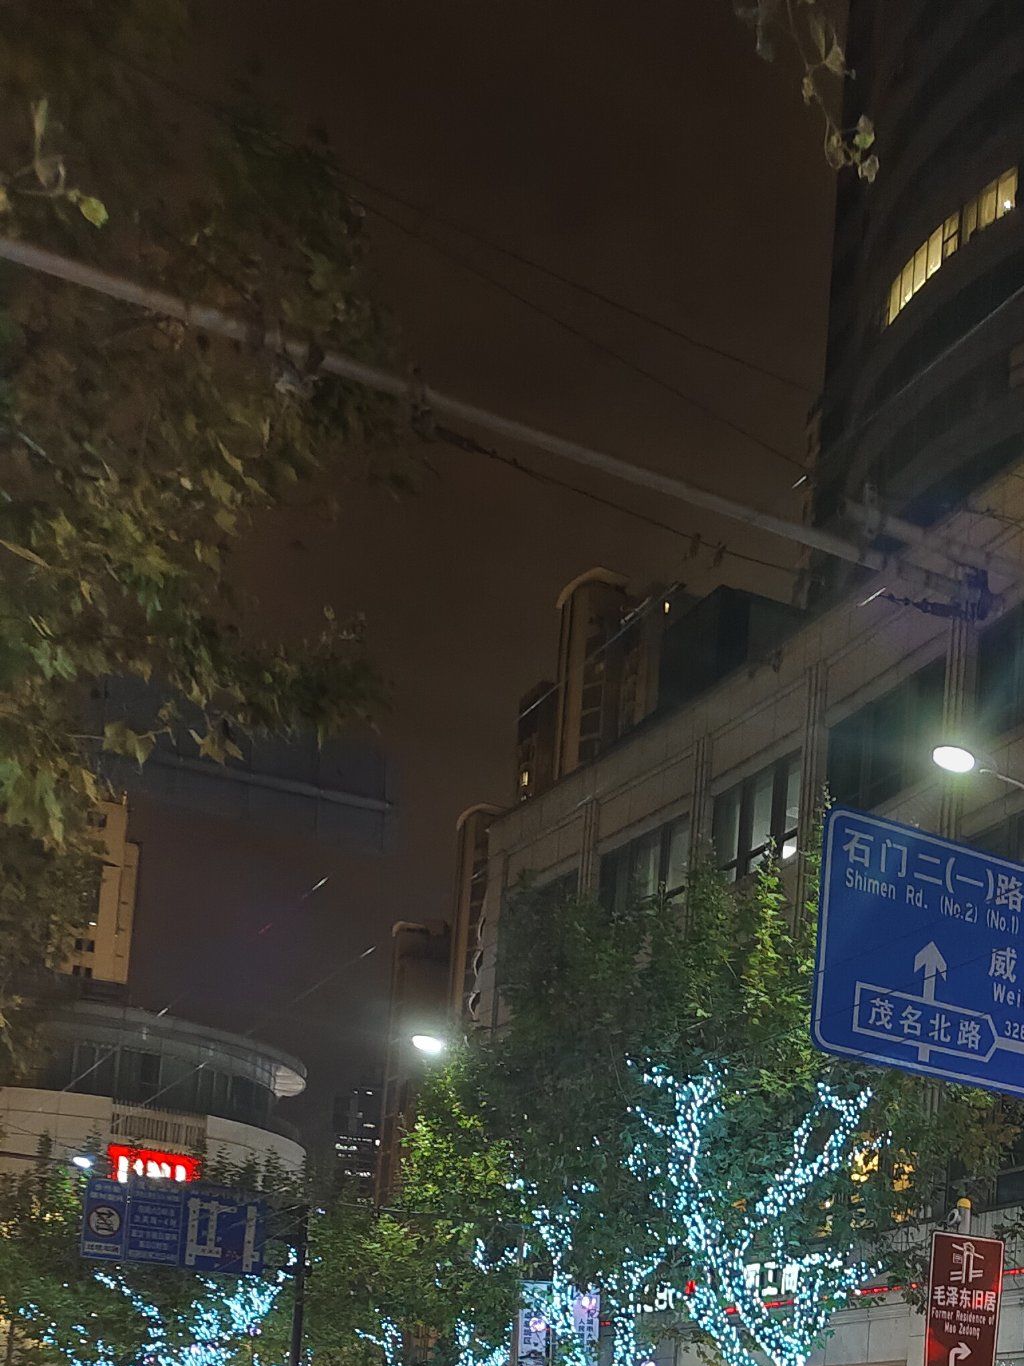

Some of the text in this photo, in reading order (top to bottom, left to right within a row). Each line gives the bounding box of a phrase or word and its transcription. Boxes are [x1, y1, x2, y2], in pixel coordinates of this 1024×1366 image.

[843, 828, 1024, 912] 石门二(一)路
[845, 868, 1019, 935] Shimen Rd. (No.2) (No.1)
[869, 997, 982, 1051] 茂名北路
[931, 1307, 995, 1325] Former Residence of
[933, 1285, 996, 1312] 毛泽东旧居
[944, 1322, 980, 1341] Mao Zedong
